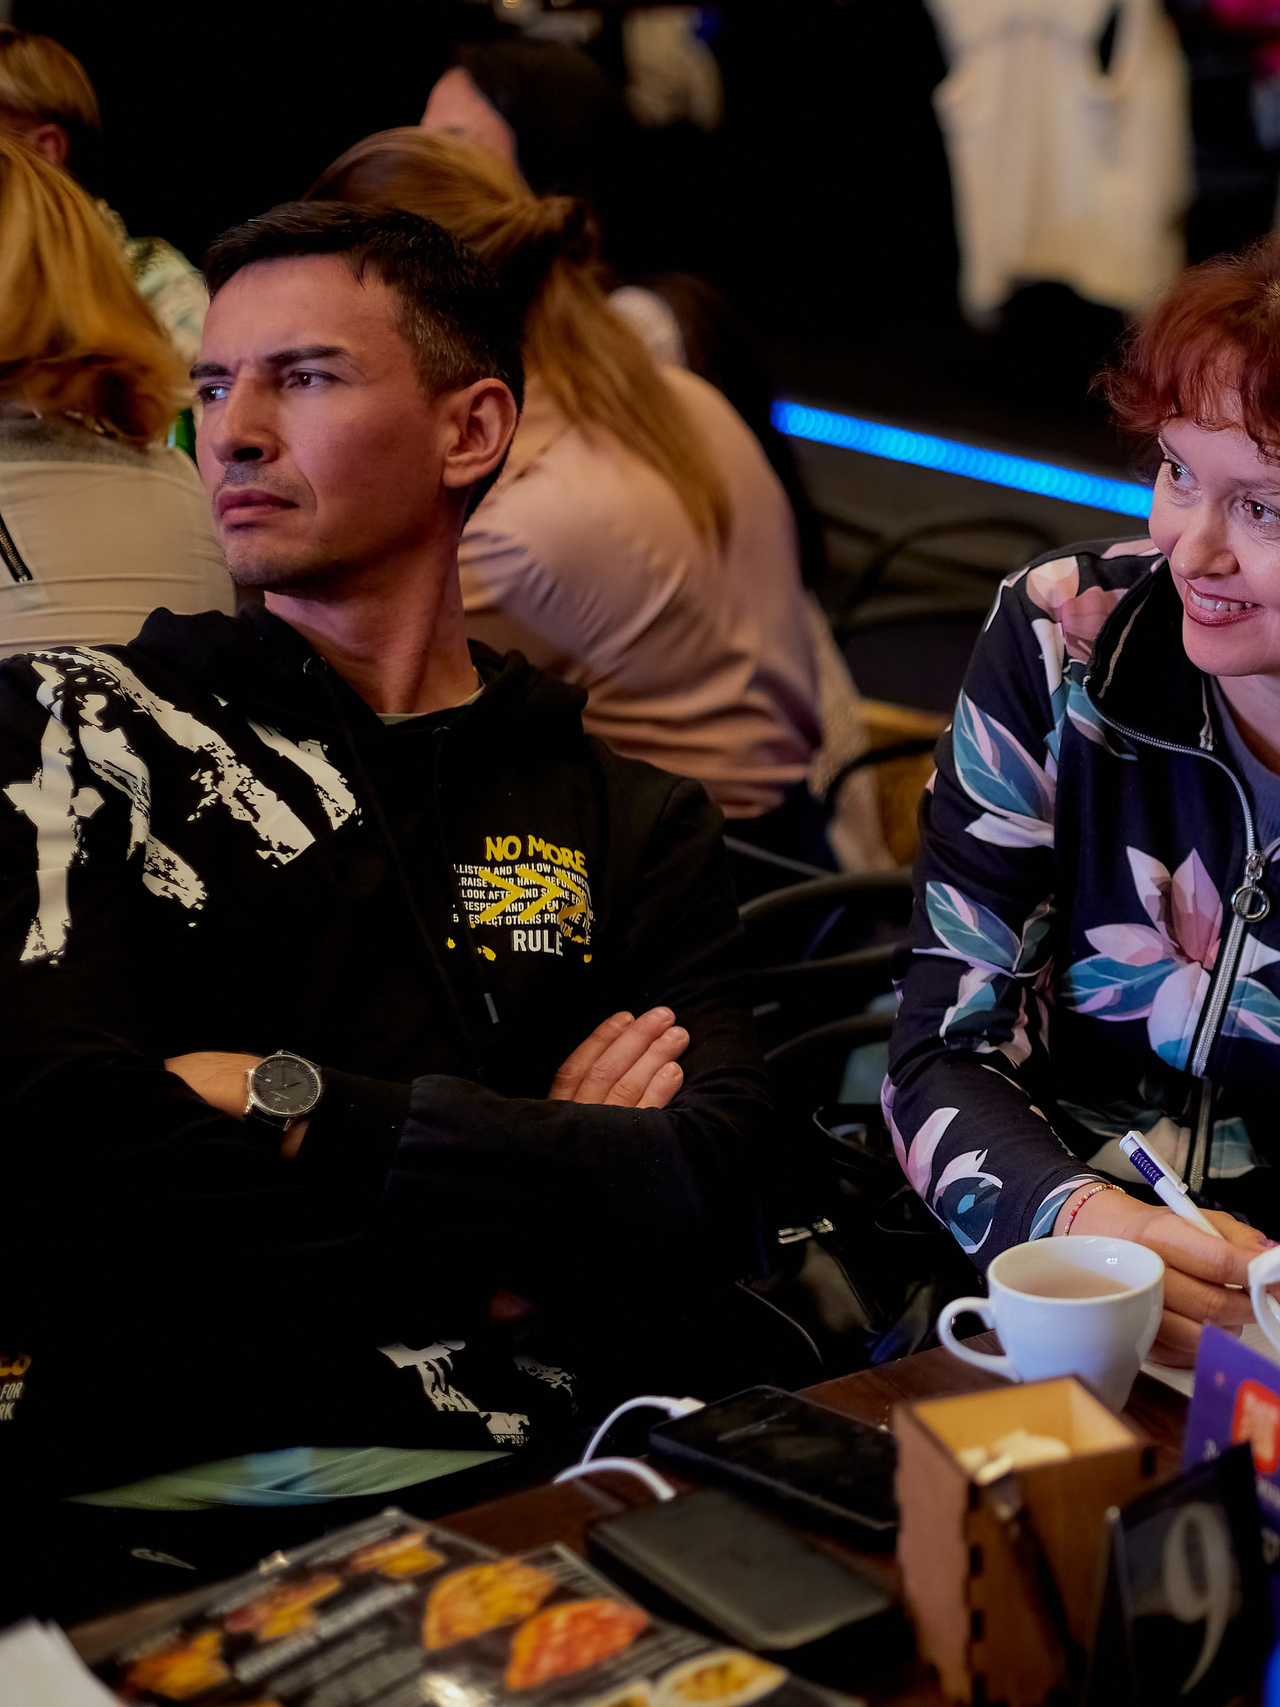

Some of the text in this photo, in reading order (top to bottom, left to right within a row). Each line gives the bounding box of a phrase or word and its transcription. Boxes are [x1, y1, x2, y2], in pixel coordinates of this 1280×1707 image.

[485, 834, 589, 878] NO MORE
[494, 865, 512, 876] AND
[461, 889, 486, 900] LOOK
[488, 890, 515, 900] AFTE
[520, 887, 539, 899] AND
[505, 902, 525, 913] AND
[512, 929, 564, 957] RULE
[1162, 1502, 1236, 1696] 9
